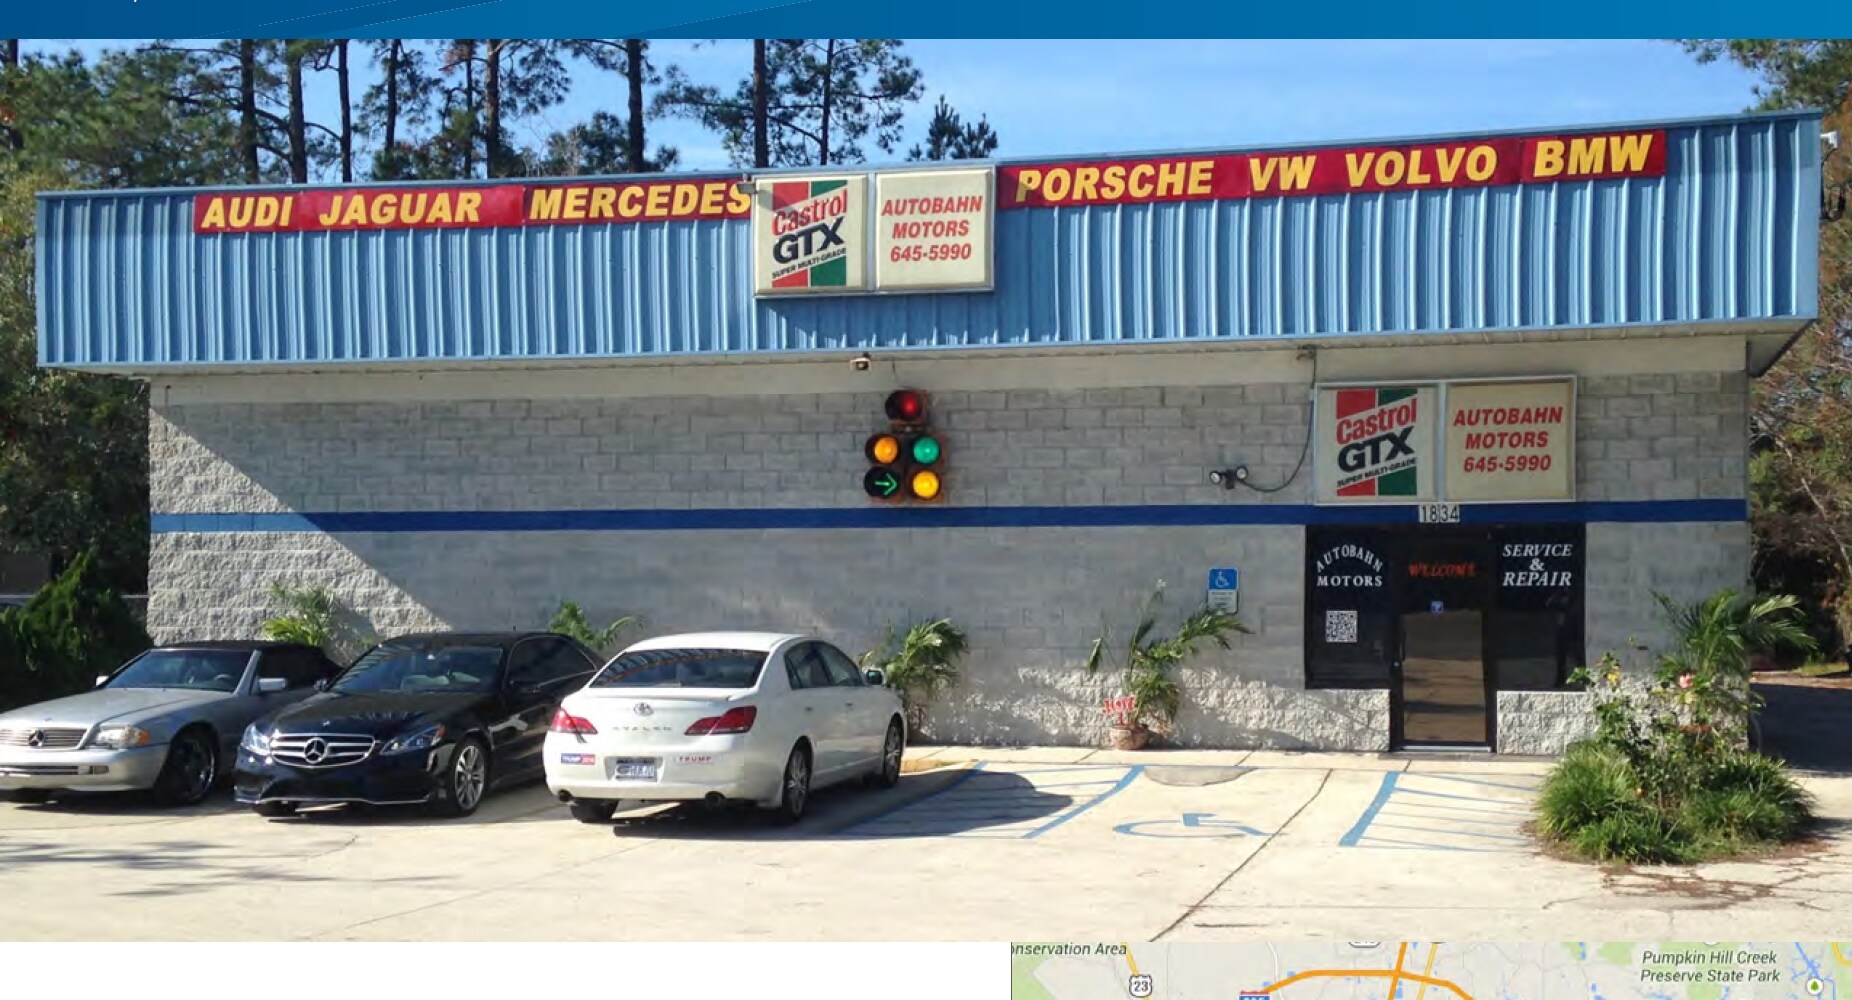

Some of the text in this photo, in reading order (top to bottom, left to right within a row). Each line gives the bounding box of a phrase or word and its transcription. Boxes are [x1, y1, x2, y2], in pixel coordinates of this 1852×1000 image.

[1016, 134, 1653, 203] PORSCHE VW VOLVO BMW
[201, 183, 751, 229] AUDI JAGUAR MERCEDES
[772, 189, 848, 236] Castrol
[881, 195, 984, 216] AUTOBAHN
[892, 220, 970, 239] MOTORS
[772, 216, 845, 264] GTX
[890, 243, 972, 263] 645-5990
[772, 247, 847, 279] SUPER MULTI-GRADE
[1336, 397, 1418, 445] Castrol
[1453, 406, 1564, 426] AUTOBAHN
[1337, 426, 1415, 473] GTX
[1465, 431, 1549, 450] MOTORS
[1463, 454, 1552, 473] 645-5990
[1336, 474, 1363, 487] SUPER
[1421, 505, 1460, 522] 1834
[1316, 544, 1384, 573] AUTOBAHN
[1502, 543, 1574, 557] SERVICE
[1408, 562, 1477, 578] WELCOME
[1529, 557, 1546, 571] &
[1316, 575, 1383, 587] MOTORS
[1502, 571, 1573, 587] REPAIR
[679, 755, 712, 763] TRUMP
